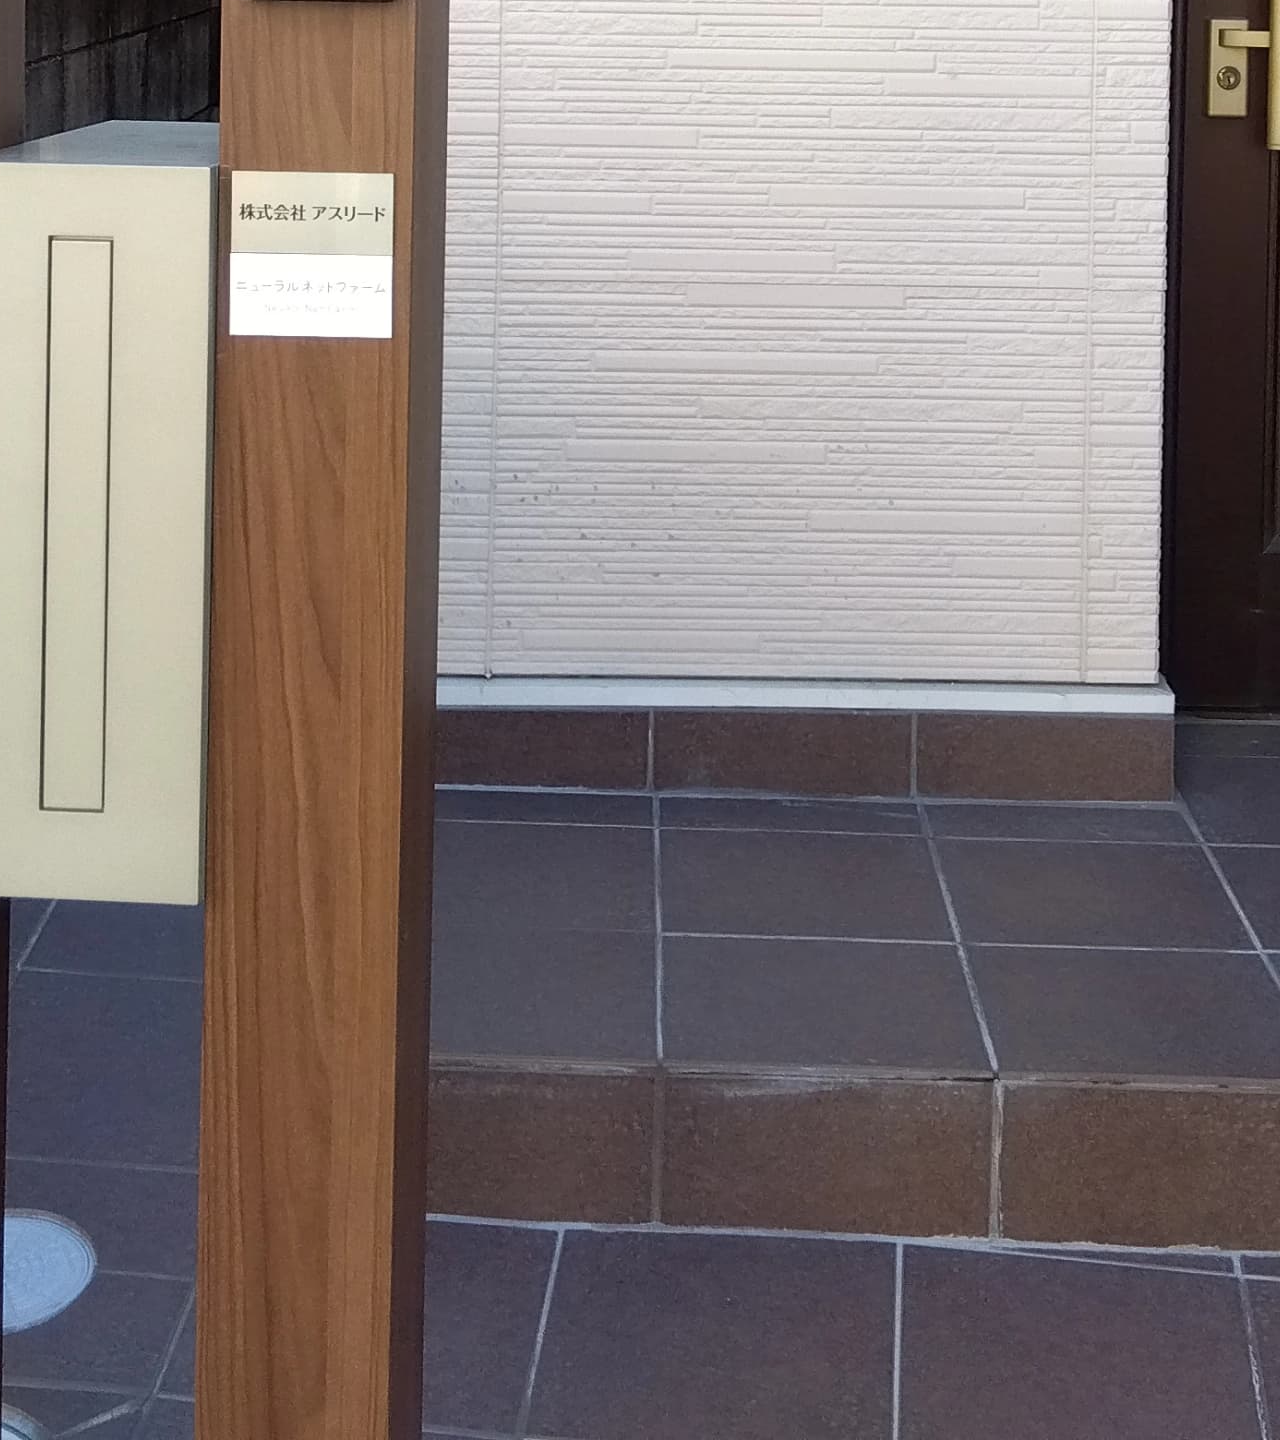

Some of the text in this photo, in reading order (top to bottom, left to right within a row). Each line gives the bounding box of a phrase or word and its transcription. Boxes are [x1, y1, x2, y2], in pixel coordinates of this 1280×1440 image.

[239, 203, 386, 222] 株式会社 アスリード
